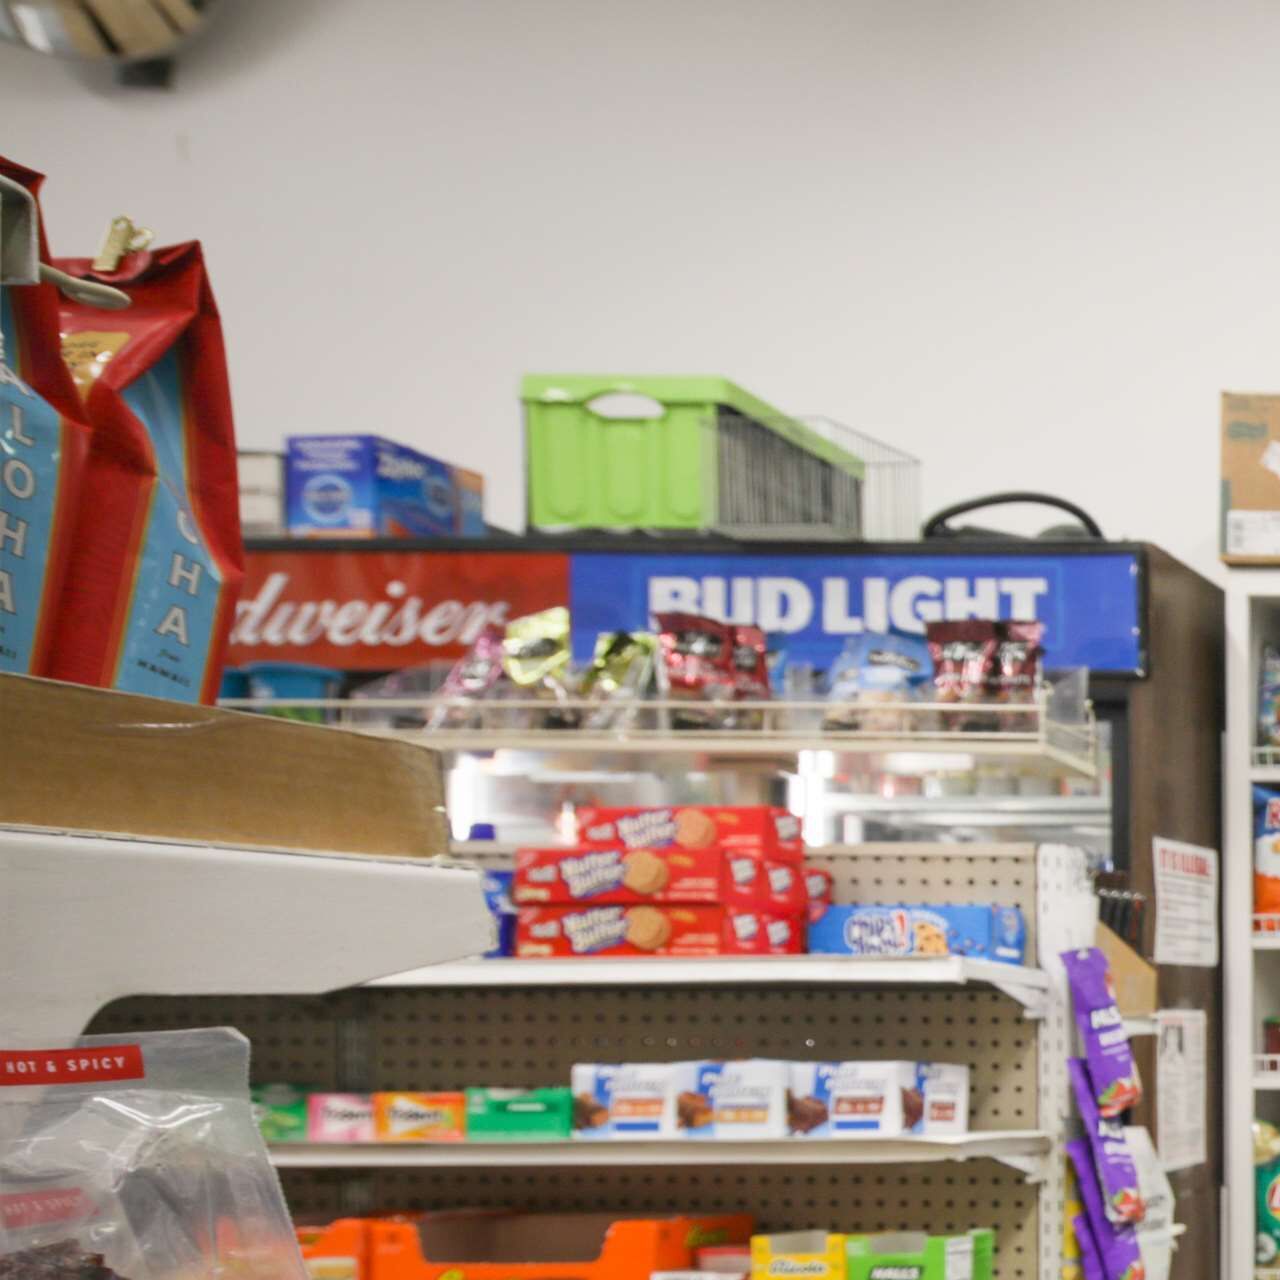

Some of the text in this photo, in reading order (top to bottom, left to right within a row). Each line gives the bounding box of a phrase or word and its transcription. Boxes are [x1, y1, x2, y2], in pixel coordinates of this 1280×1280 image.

[230, 573, 510, 648] dweiser
[648, 577, 1048, 634] BUD LIGHT
[6, 1057, 126, 1073] HOT & SPICY
